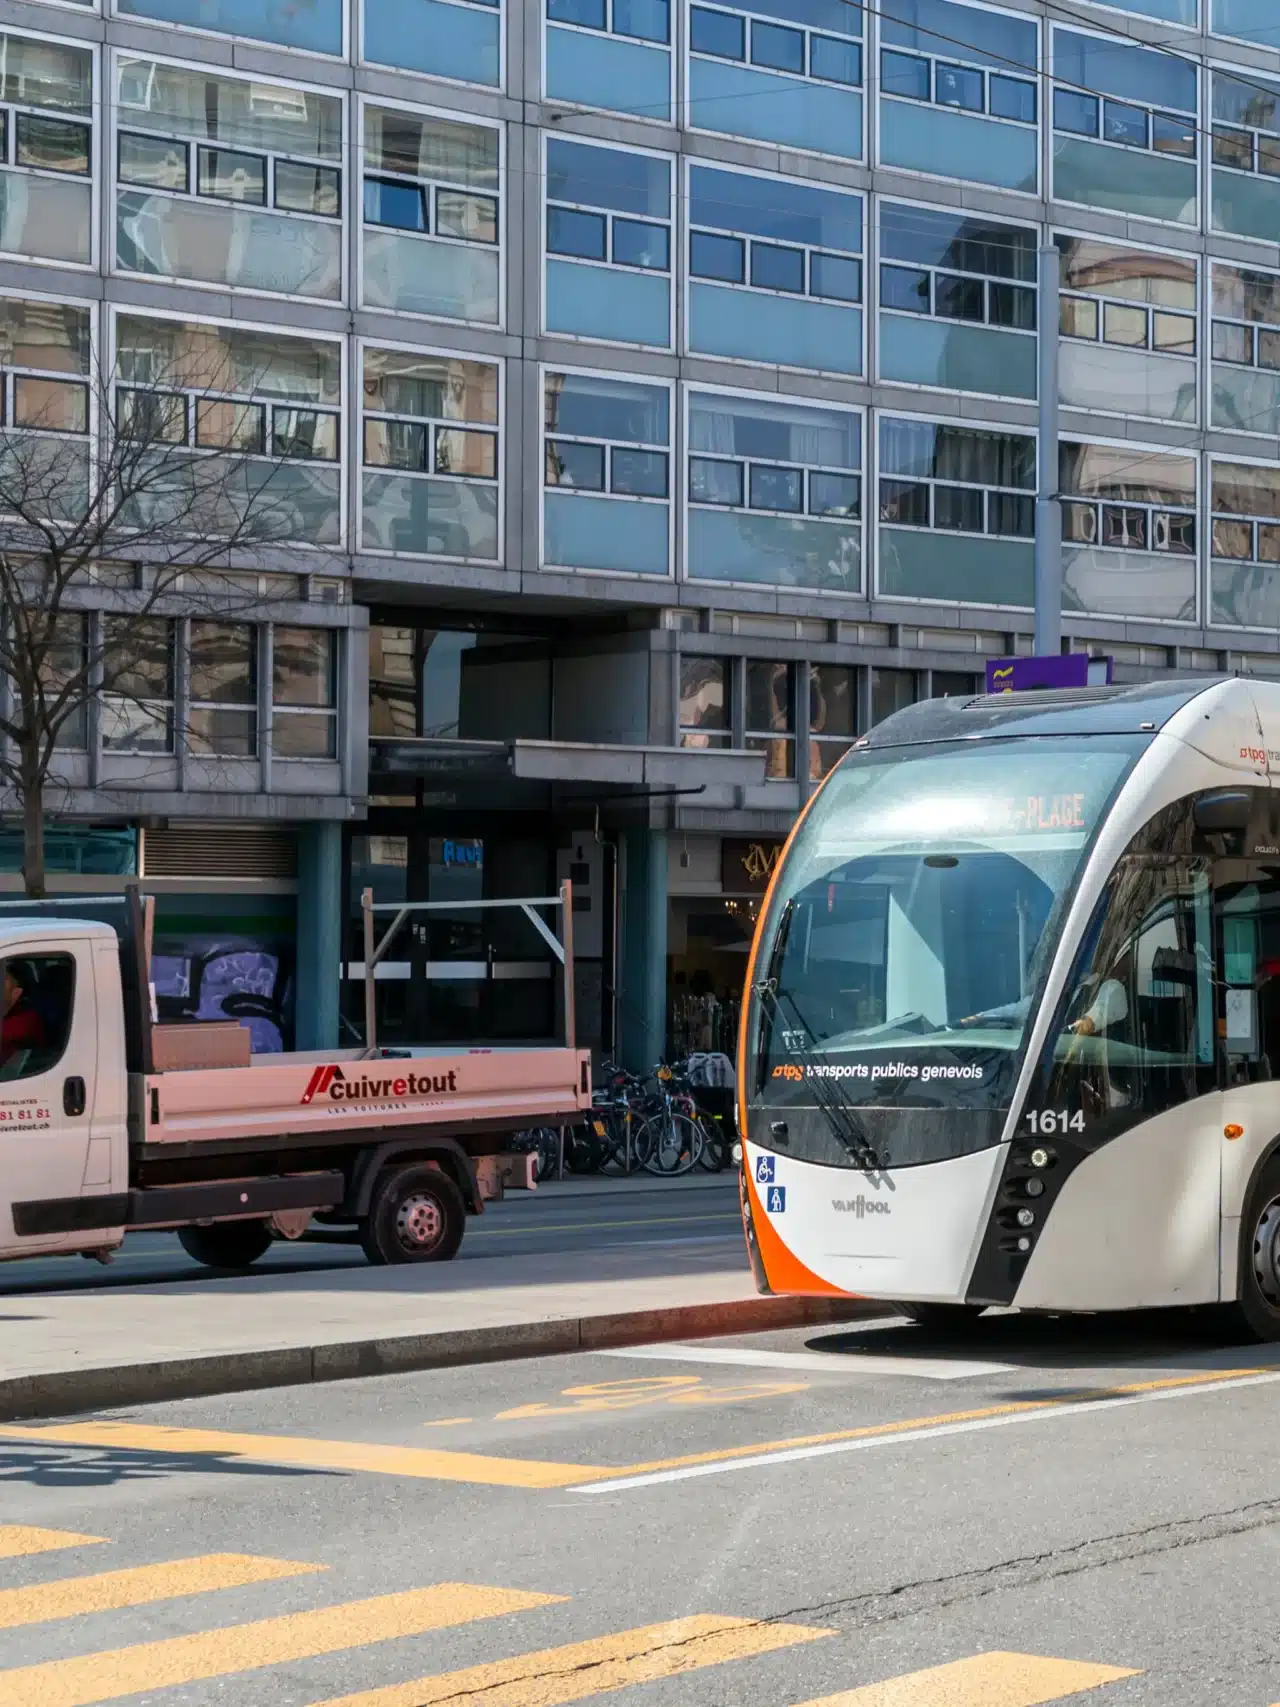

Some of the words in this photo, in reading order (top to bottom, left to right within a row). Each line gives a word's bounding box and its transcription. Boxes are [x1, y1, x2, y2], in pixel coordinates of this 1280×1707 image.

[806, 1063, 869, 1078] transports
[871, 1061, 918, 1081] publics
[921, 1063, 984, 1081] genevois
[329, 1070, 457, 1100] cuivretout
[36, 1108, 52, 1119] 81
[1026, 1109, 1086, 1133] 1614
